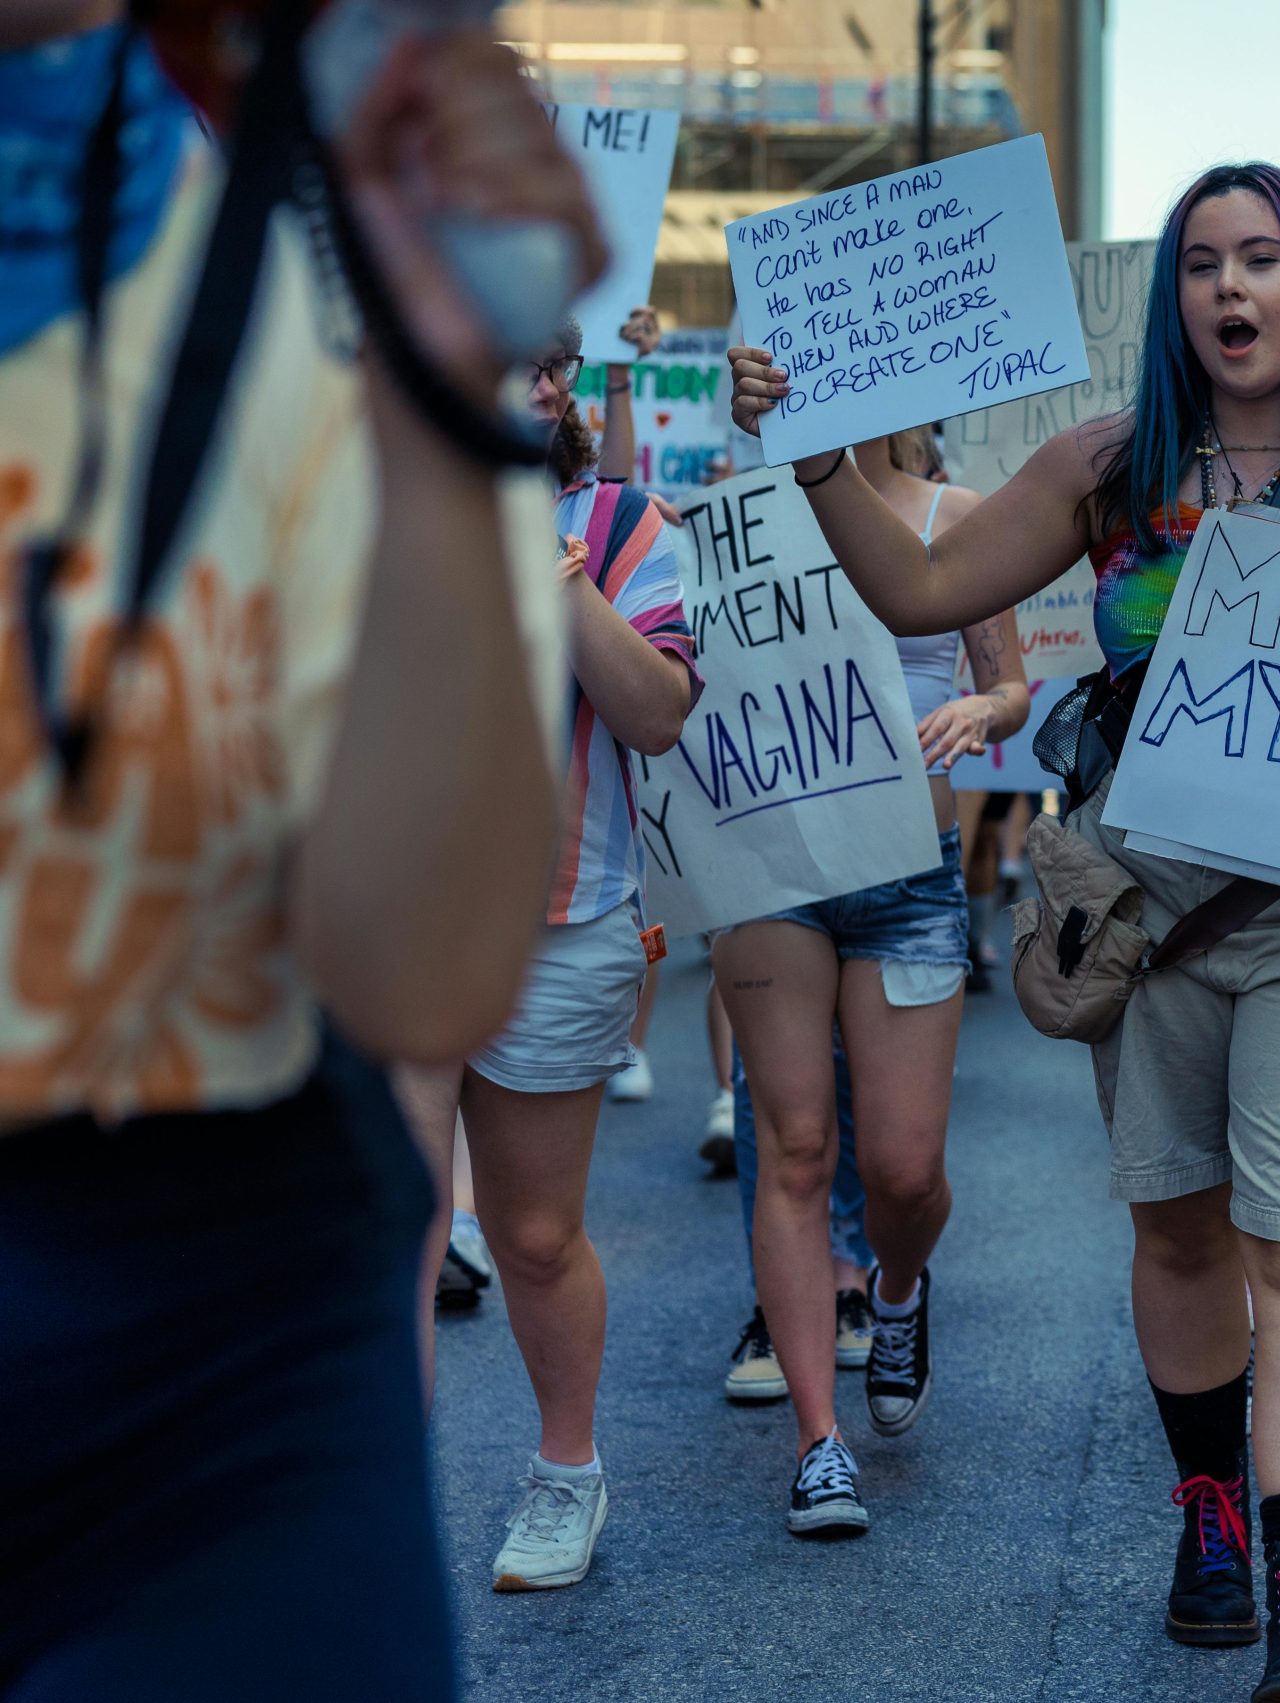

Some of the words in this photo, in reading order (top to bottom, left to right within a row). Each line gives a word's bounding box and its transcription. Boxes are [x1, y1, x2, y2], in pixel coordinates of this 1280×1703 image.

[583, 108, 650, 153] ME!
[795, 193, 857, 232] SINCE
[866, 183, 880, 210] A
[889, 169, 943, 201] MAN
[766, 291, 799, 319] He
[804, 277, 852, 308] has
[868, 253, 904, 286] NO
[914, 211, 1004, 267] RIGHT
[833, 219, 905, 260] make
[762, 328, 793, 358] TO
[804, 306, 863, 342] TELL
[872, 290, 886, 316] A
[893, 253, 997, 311] WOMAN
[848, 319, 899, 353] AND
[908, 286, 997, 336] WHERE
[812, 347, 926, 404] CREATE
[958, 341, 1067, 399] TUPAC
[680, 484, 776, 588] THE
[677, 658, 899, 811] VAGINA
